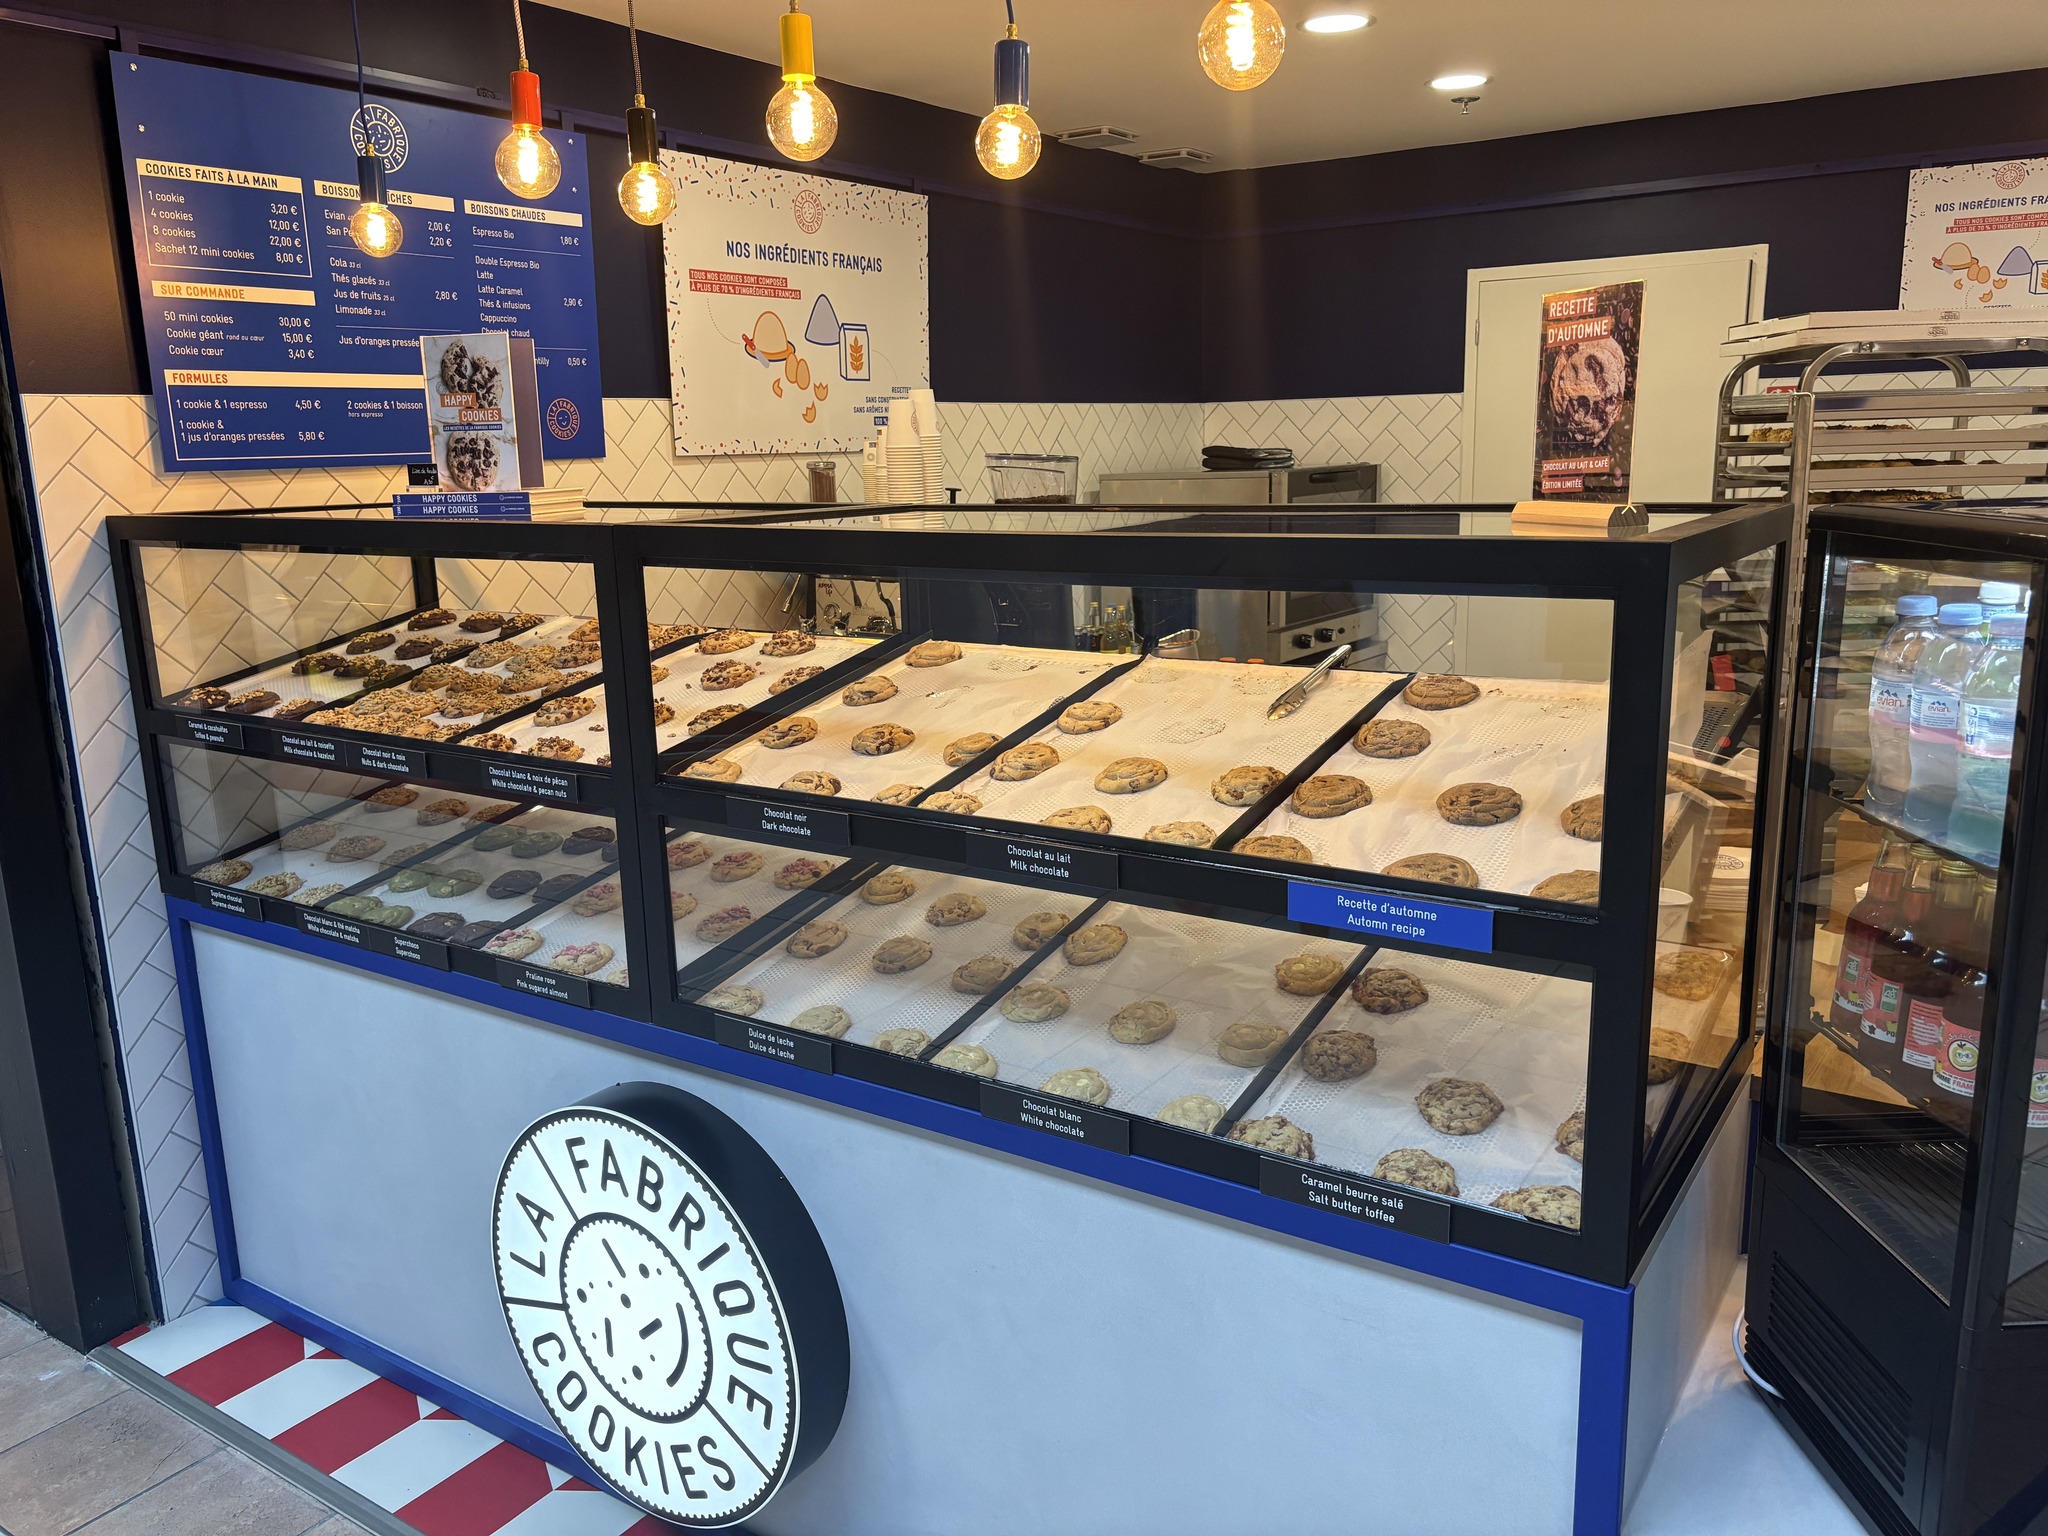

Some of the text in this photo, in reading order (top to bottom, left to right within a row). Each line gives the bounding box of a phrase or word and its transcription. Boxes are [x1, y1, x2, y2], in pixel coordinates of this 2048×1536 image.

[145, 162, 278, 188] COOKIES FAITS À LA MAIN
[156, 192, 185, 203] cookie
[1935, 195, 2048, 213] NOS INGRÉDIENTS FRA
[159, 209, 193, 221] cookies
[270, 203, 297, 215] 3,20 €
[470, 203, 546, 221] BOISSONS CHAUDES
[153, 225, 196, 238] 8 cookies
[268, 219, 299, 231] 12,00 €
[472, 226, 514, 239] Espresso Bio
[270, 236, 302, 248] 22,00 €
[155, 242, 255, 260] Sachet 12 mini cookies
[276, 253, 303, 264] 8,00 €
[726, 240, 882, 275] NOS INGRÉDIENTS FRANÇAIS
[475, 256, 540, 269] Double Espresso Bio
[477, 270, 494, 280] Latte
[690, 271, 786, 287] TOUS NOS COOKIES SONT COMPOSÉS
[160, 284, 245, 299] SUR COMMANDE
[478, 284, 523, 296] Latte Caramel
[697, 282, 711, 292] PLUS
[713, 284, 720, 292] DE
[721, 285, 729, 293] 70
[735, 286, 774, 297] D'INGRÉDIENTS
[775, 289, 800, 299] FRANÇAIS
[479, 299, 494, 308] Thés
[502, 300, 530, 310] infusions
[1550, 296, 1594, 318] RECETTE
[164, 311, 234, 324] 50 mini cookies
[279, 317, 310, 327] 30,00 €
[480, 313, 517, 324] Cappuccino
[1548, 319, 1608, 344] D'AUTOMNE
[168, 344, 224, 356] Cookie cœur
[288, 349, 314, 360] 3,40 €
[173, 373, 228, 384] FORMULES
[444, 395, 472, 406] HAPPY
[461, 410, 499, 421] COOKIES
[866, 405, 884, 413] ARÔMES
[187, 432, 201, 443] jus
[203, 431, 246, 443] d'oranges
[248, 431, 285, 443] pressées
[1543, 461, 1568, 472] CHOCOLAT
[1569, 460, 1576, 470] AU
[1577, 460, 1588, 469] LAIT
[1595, 457, 1608, 468] CAFÉ
[1542, 478, 1582, 490] ÉDITION LIMITÉE
[422, 494, 477, 503] HAPPY COOKIES
[423, 505, 478, 514] HAPPY COOKIES
[488, 766, 511, 777] Chocolat
[512, 770, 526, 780] blanc
[544, 775, 550, 783] de
[491, 778, 506, 788] White
[507, 781, 532, 792] chocolate
[539, 787, 554, 796] pecan
[555, 789, 567, 798] nuts
[764, 807, 807, 822] Chocolat noir
[762, 820, 811, 836] Dark chocolate
[1007, 844, 1071, 863] Chocolat au lait
[1010, 859, 1069, 878] Milk chocolate
[1337, 895, 1437, 921] Recette d'automne
[1347, 914, 1425, 938] Automn recipe
[394, 936, 420, 950] Superchoco
[395, 946, 421, 960] Superchoco
[526, 970, 556, 985] Praline rose
[516, 979, 568, 999] Pink sugared almond
[749, 1027, 794, 1048] Dulce de leche
[749, 1040, 794, 1060] Dulce de leche
[1023, 1099, 1082, 1123] Chocolat blanc
[1020, 1112, 1085, 1138] White chocolate
[1301, 1173, 1404, 1210] Caramel beurre salé
[1308, 1191, 1395, 1223] Salt butter toffee
[509, 1192, 555, 1278] LA
[564, 1136, 774, 1431] FABRIQUE
[531, 1331, 737, 1500] COOKIES
